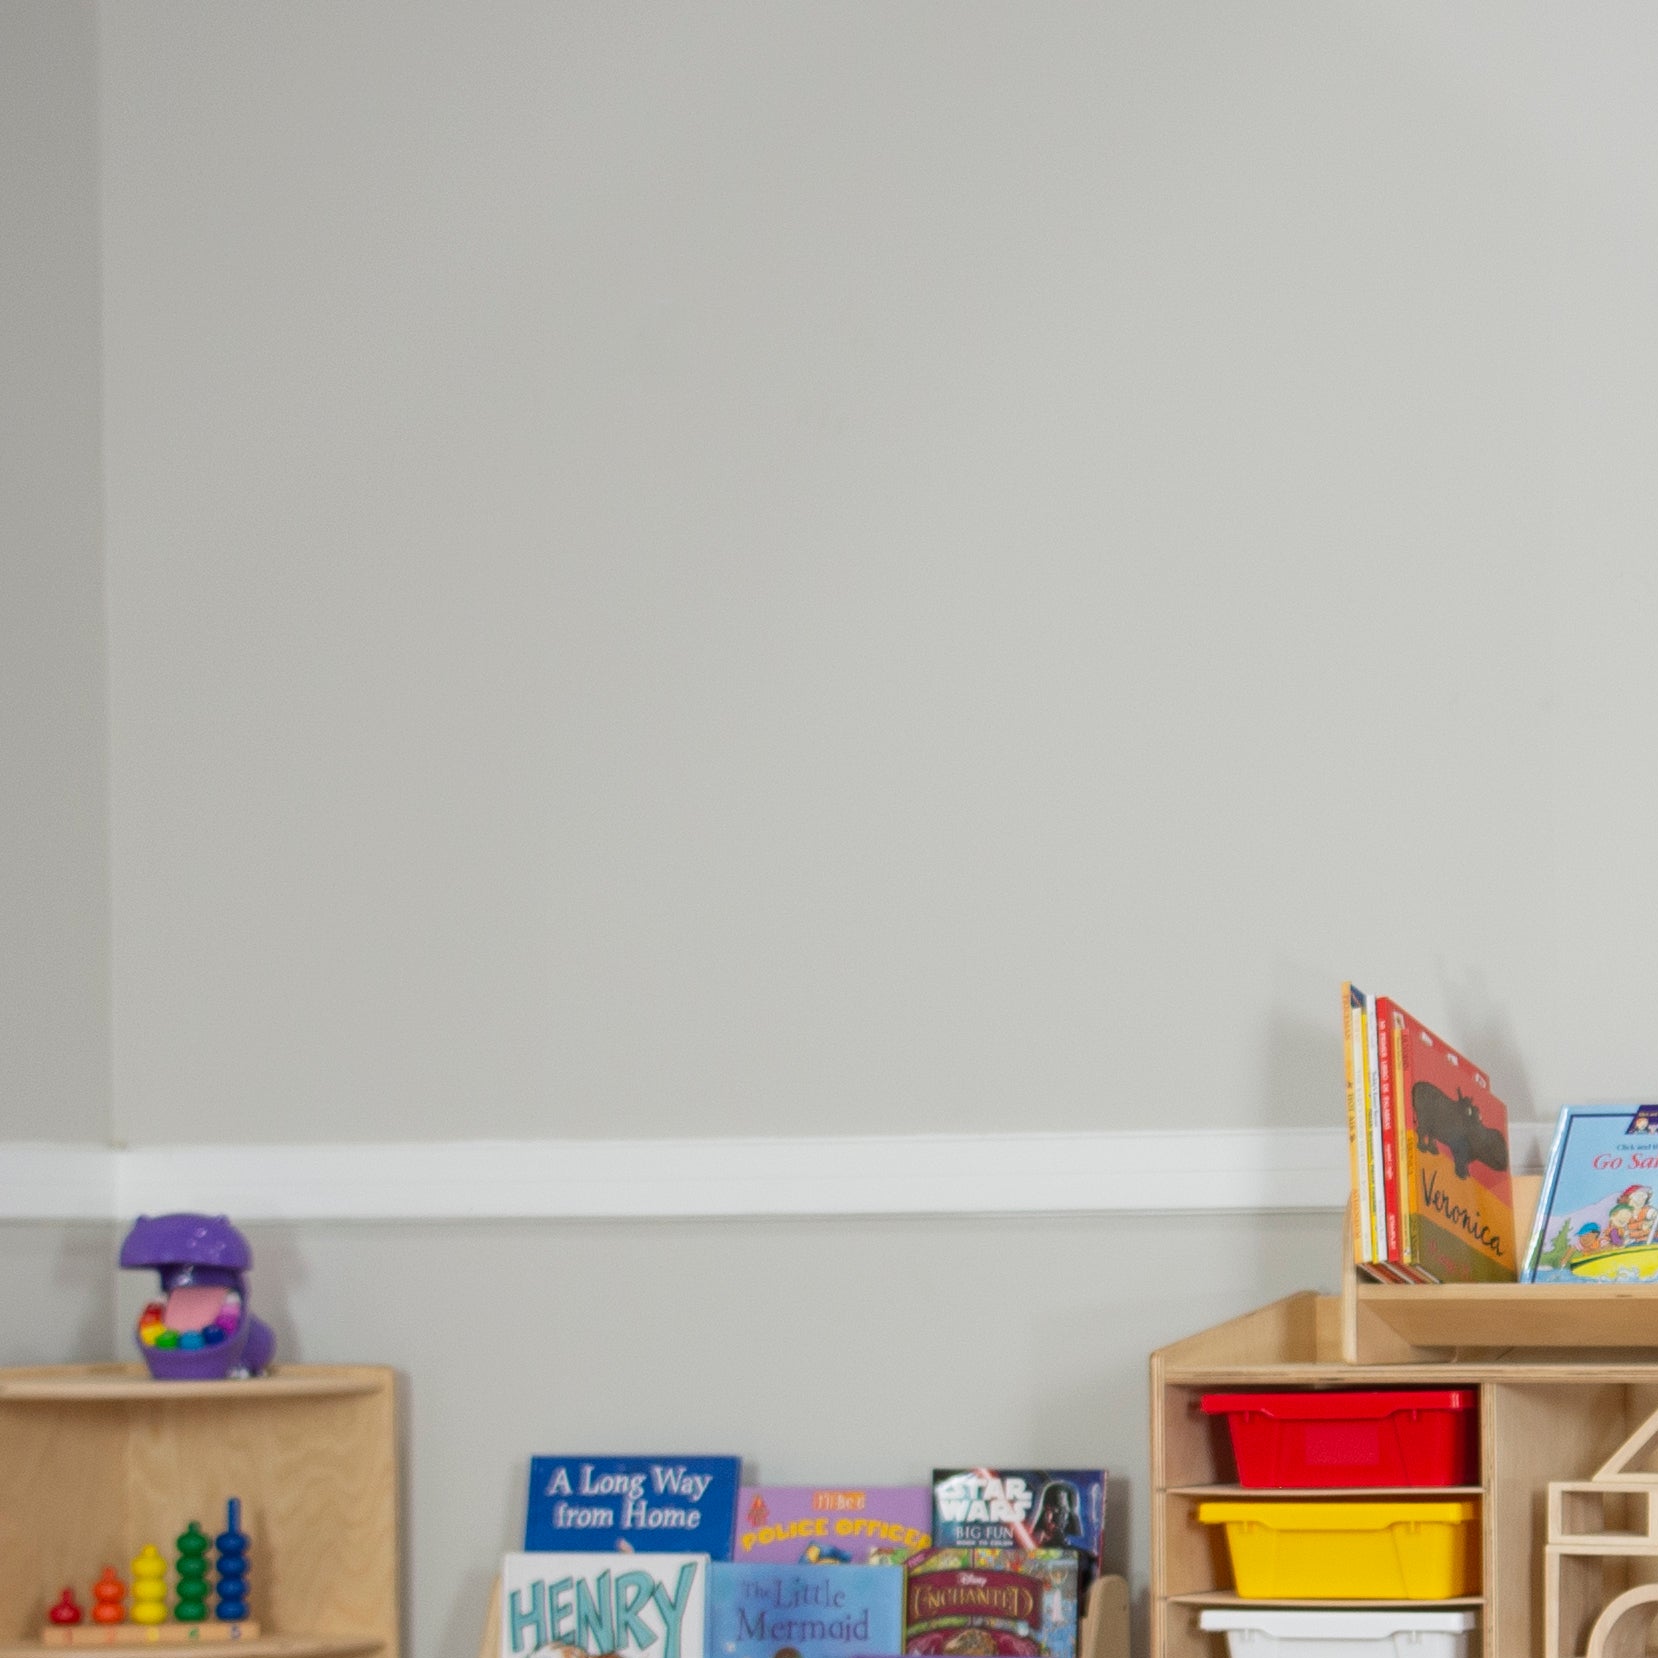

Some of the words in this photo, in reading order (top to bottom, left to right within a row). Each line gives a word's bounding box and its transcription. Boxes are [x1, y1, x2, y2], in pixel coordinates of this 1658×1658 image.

[1592, 1153, 1622, 1171] Go
[1617, 1143, 1635, 1151] Click
[1636, 1143, 1651, 1151] and
[1421, 1167, 1503, 1257] Veronica
[549, 1467, 572, 1496] A
[578, 1464, 647, 1500] Long
[652, 1465, 713, 1502] Way
[937, 1476, 1033, 1501] STAR
[554, 1501, 614, 1529] from
[618, 1499, 702, 1530] Home
[938, 1496, 1032, 1523] WARS
[740, 1518, 830, 1553] POLICE
[834, 1517, 932, 1550] OFFICER
[956, 1525, 982, 1539] BIG
[986, 1525, 1014, 1539] FUN
[742, 1580, 769, 1599] The
[773, 1577, 846, 1610] Little
[914, 1584, 1034, 1619] ENCHANTED
[736, 1607, 870, 1643] Mermaid
